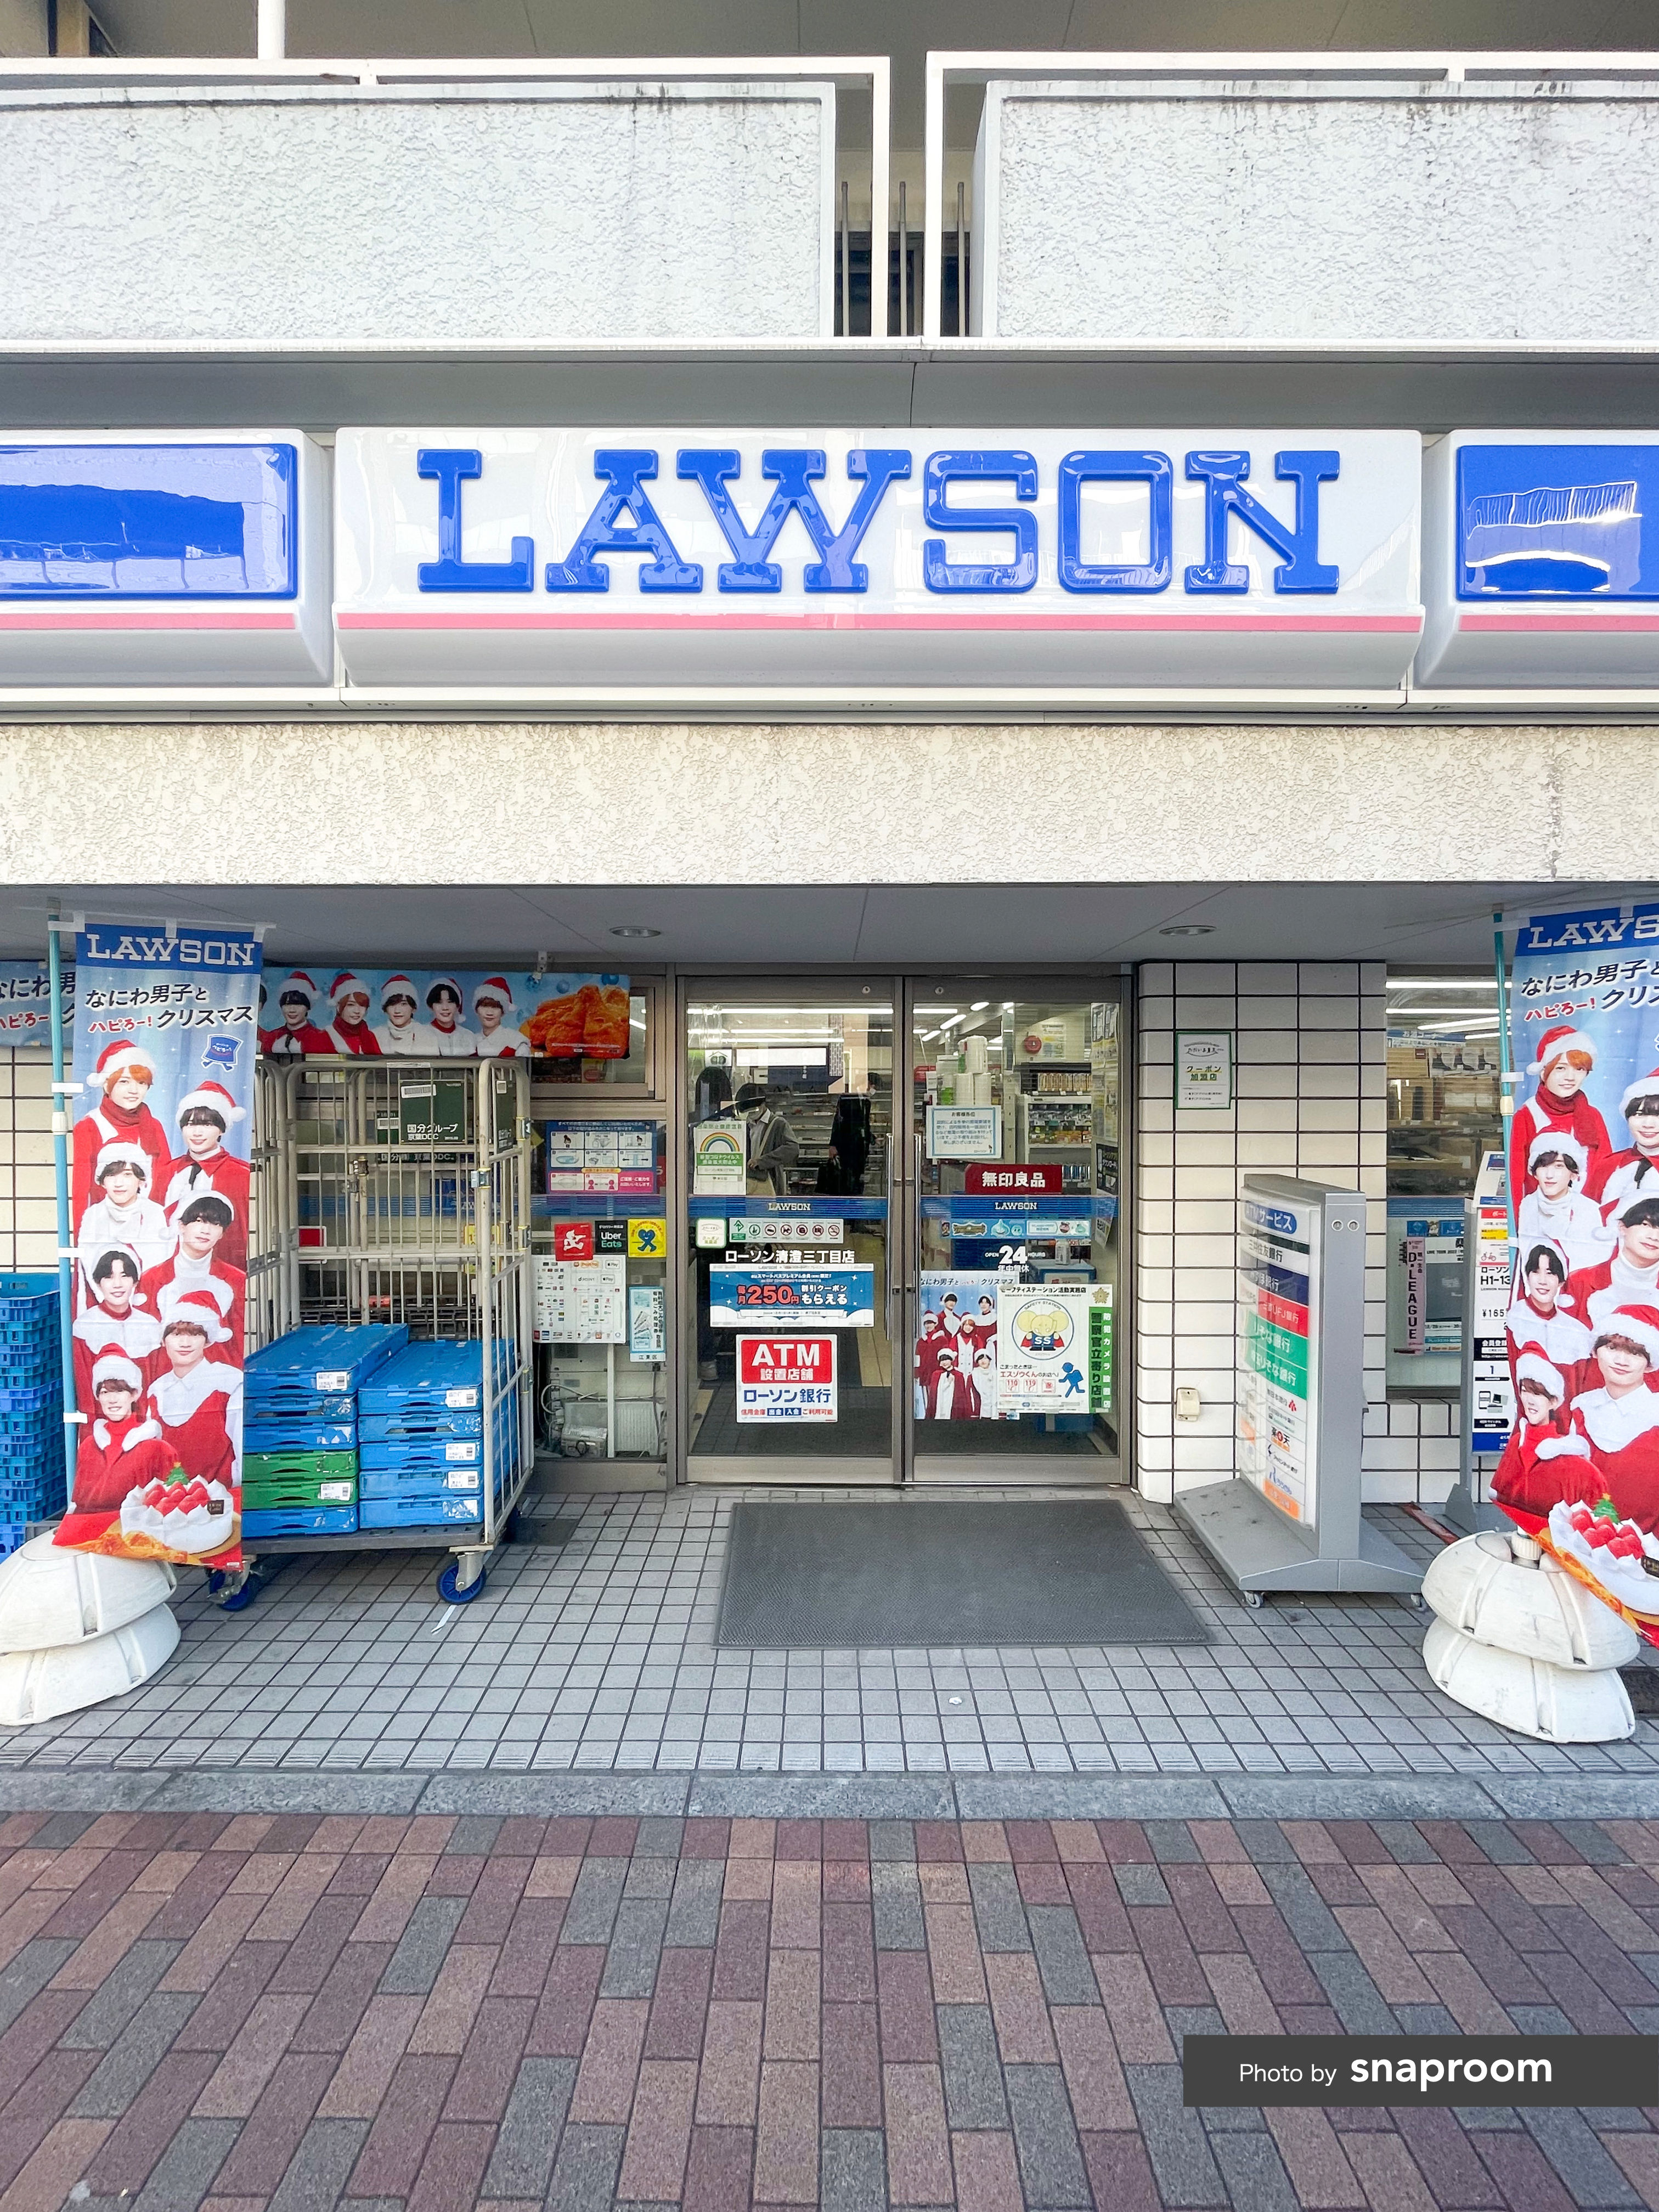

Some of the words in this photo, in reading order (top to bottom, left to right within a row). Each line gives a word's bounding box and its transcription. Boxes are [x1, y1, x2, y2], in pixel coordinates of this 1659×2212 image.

[417, 449, 1340, 594] LAWSON
[86, 934, 255, 966] LAWSON
[85, 983, 207, 1008] なにわ男子と
[1525, 997, 1595, 1021] ハピろー!
[88, 1016, 152, 1032] ハピろー!
[157, 1006, 253, 1029] クリスマス
[407, 1124, 458, 1133] 国分グループ
[981, 1171, 1046, 1188] 無印良品
[769, 1203, 811, 1211] LAWSON
[995, 1202, 1037, 1210] LAWSON
[601, 1232, 622, 1240] Uber
[725, 1250, 855, 1263] ローソン清澄三丁目店
[999, 1245, 1028, 1265] 24
[801, 1284, 848, 1293] 割引クーポン
[801, 1293, 848, 1305] もらえる
[1024, 1301, 1041, 1310] SAFETY
[1042, 1301, 1062, 1310] STATION
[1482, 1309, 1504, 1317] ¥165
[1034, 1336, 1052, 1345] SS
[752, 1344, 820, 1367] ATM
[760, 1368, 814, 1381] 設置店舗
[1489, 1365, 1494, 1374] 1
[744, 1389, 831, 1403] ローソン銀行
